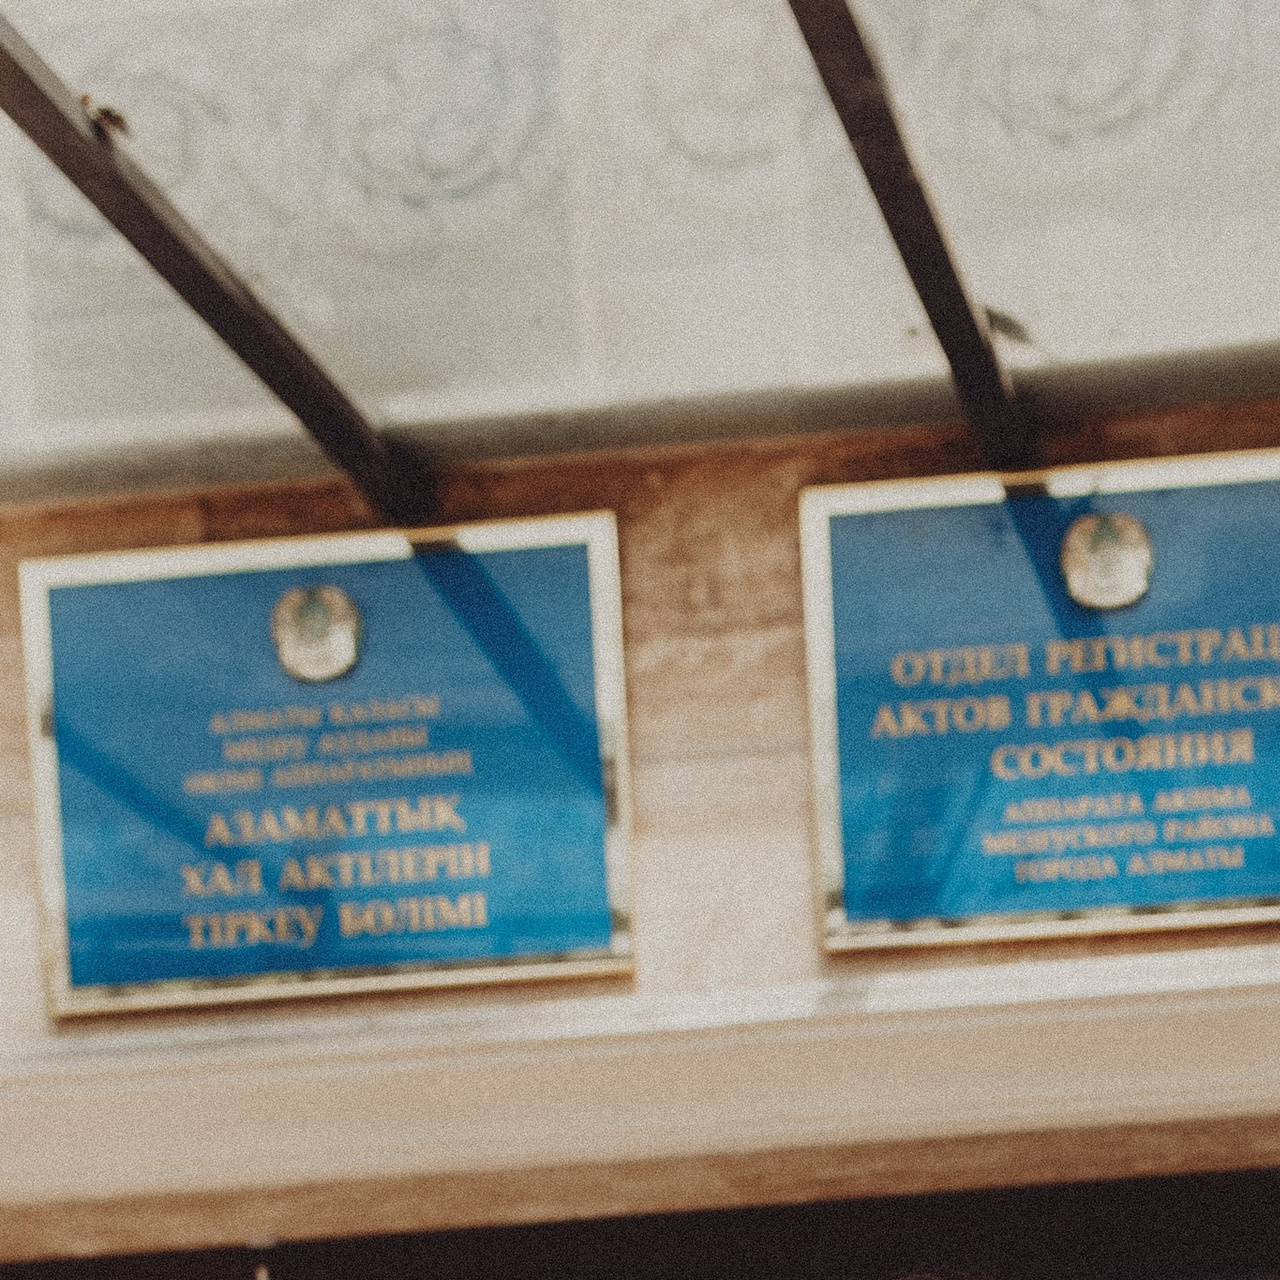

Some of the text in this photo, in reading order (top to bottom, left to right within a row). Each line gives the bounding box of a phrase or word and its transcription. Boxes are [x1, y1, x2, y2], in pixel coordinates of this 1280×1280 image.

[890, 642, 1030, 687] ОТДЕЛ
[870, 694, 1011, 738] АКТОВ
[990, 729, 1255, 781] СОСТОЯНИЯ
[181, 858, 263, 899] ХАЛ
[181, 904, 323, 949] ТІРКЕУ
